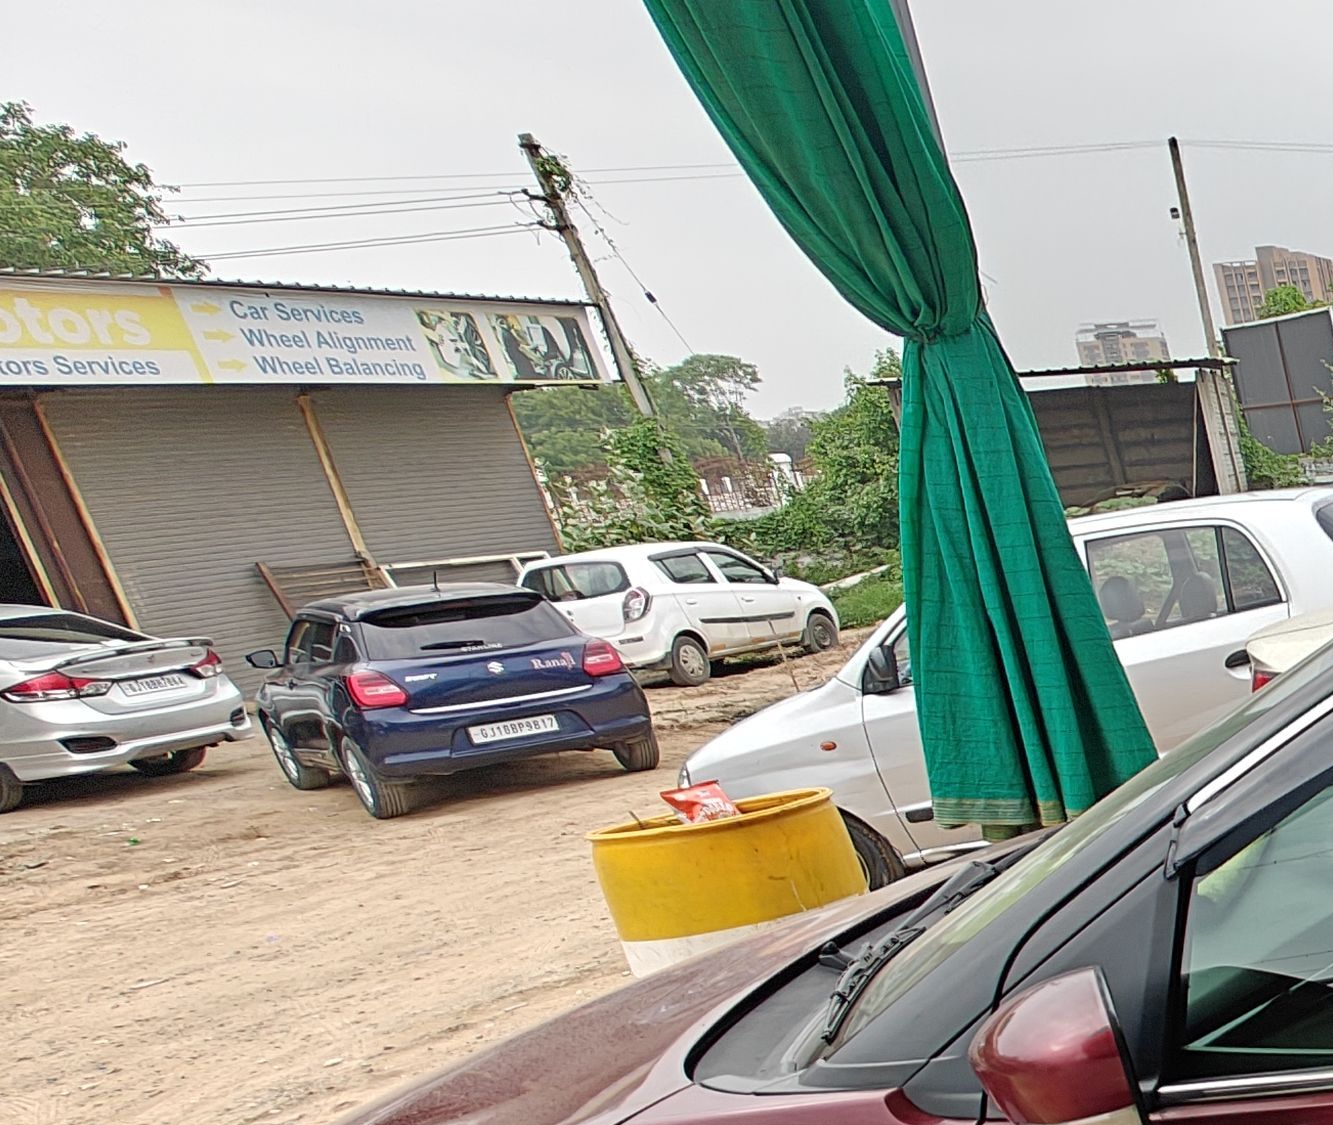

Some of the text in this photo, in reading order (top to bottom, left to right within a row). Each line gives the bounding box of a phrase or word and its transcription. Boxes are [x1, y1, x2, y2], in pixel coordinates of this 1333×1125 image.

[229, 300, 364, 325] Car Services
[240, 327, 416, 355] Wheel Alignment
[53, 355, 160, 376] Services
[253, 356, 427, 380] Wheel Balancing
